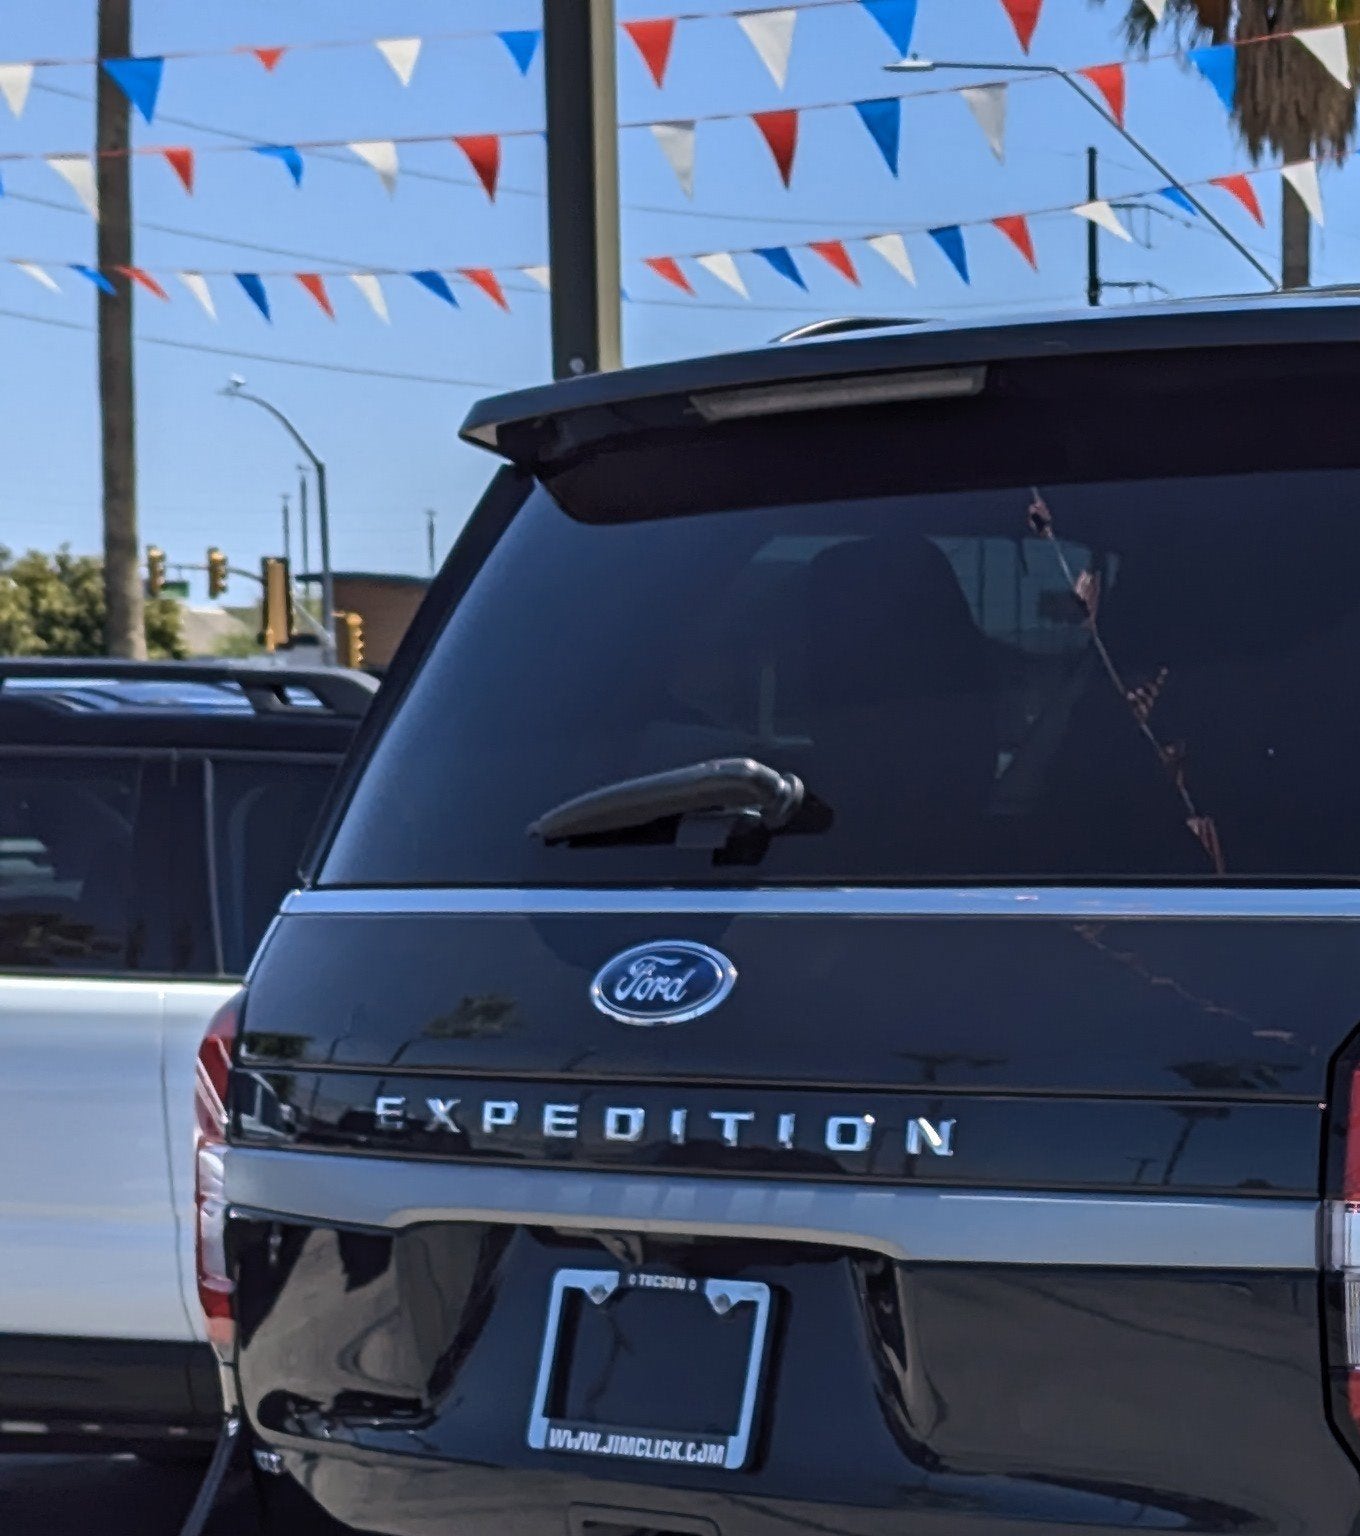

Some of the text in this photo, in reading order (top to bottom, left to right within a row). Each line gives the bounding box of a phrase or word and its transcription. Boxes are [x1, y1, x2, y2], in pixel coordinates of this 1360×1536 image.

[613, 954, 691, 1003] Ford
[374, 1096, 956, 1157] EXPEDITION
[638, 1273, 687, 1291] TUCSON
[549, 1428, 726, 1465] WWW.JIMCLICK.COM
